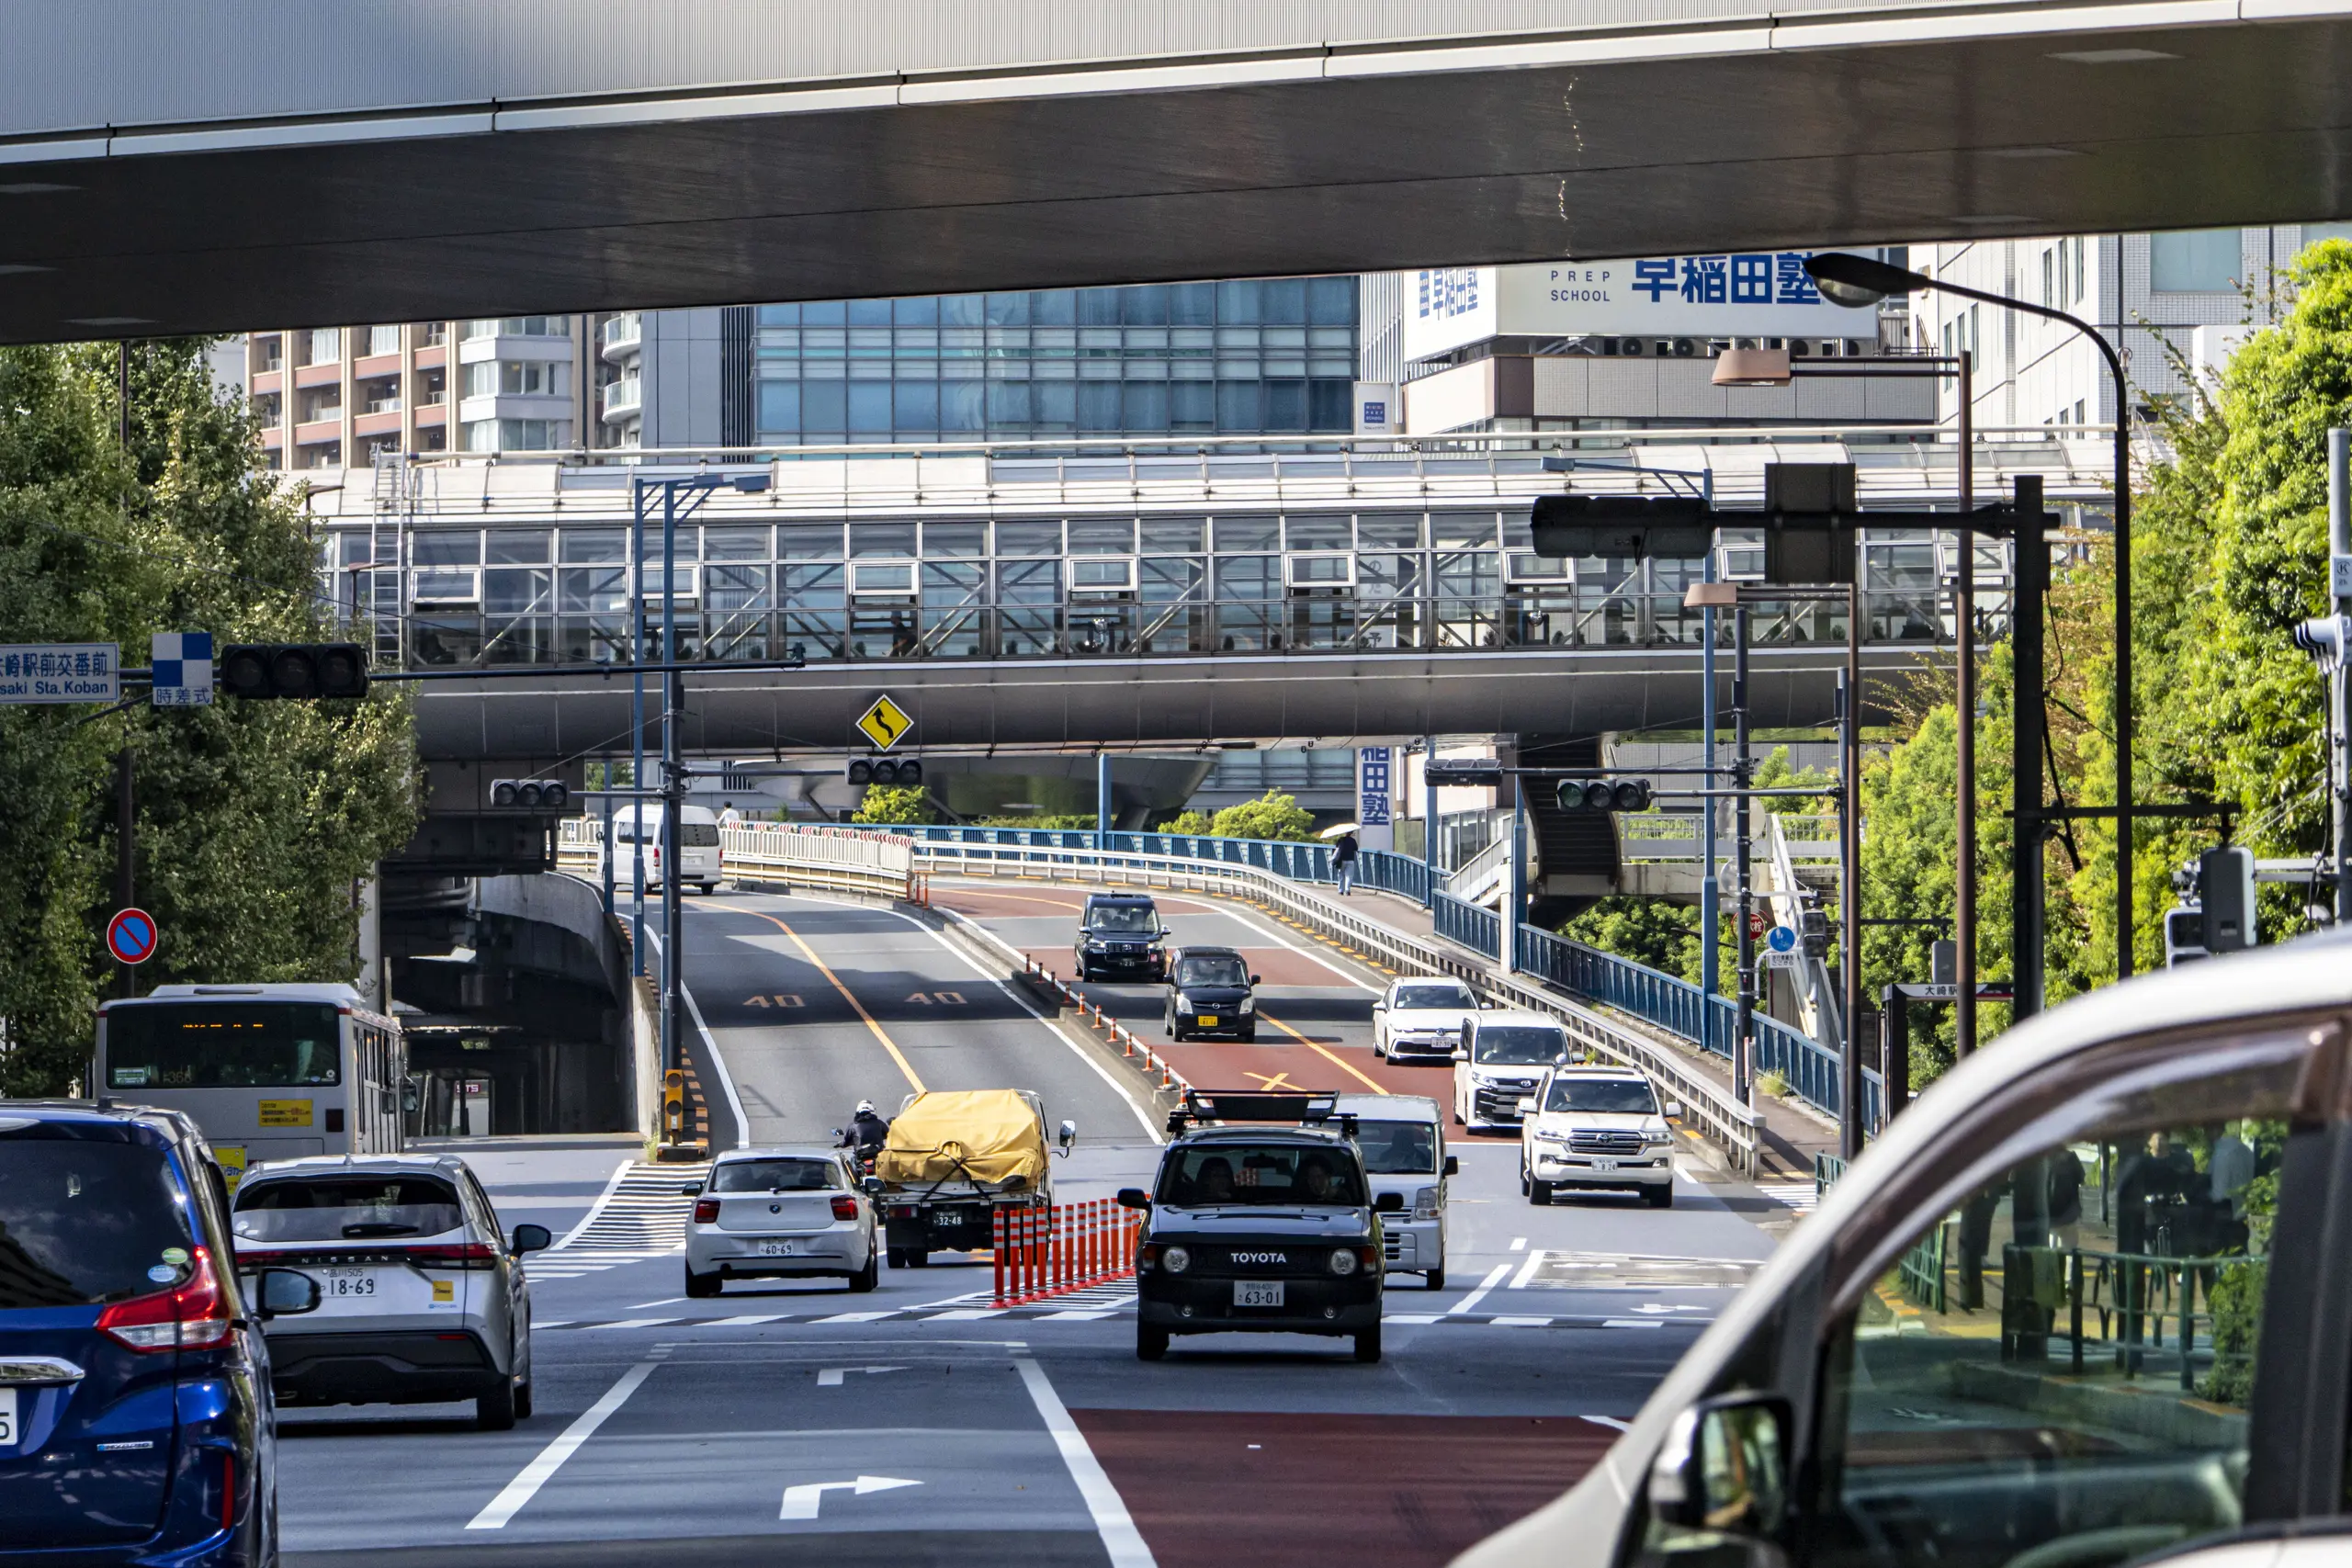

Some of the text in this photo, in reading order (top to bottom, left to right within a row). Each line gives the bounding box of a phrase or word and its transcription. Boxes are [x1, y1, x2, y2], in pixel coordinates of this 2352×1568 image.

[1551, 270, 1611, 282] PREP
[1632, 252, 1821, 304] 早稲田塾
[1551, 290, 1611, 302] SCHOOL
[0, 651, 107, 677] 崎駅前交番前
[64, 681, 108, 694] Koban
[156, 688, 210, 704] 時差式
[742, 995, 807, 1008] 40
[904, 992, 968, 1005] 40
[939, 1216, 962, 1225] 32-48
[765, 1245, 792, 1255] 60-69
[301, 1256, 389, 1264] NISSAN
[1230, 1252, 1286, 1263] TOYOTA
[331, 1279, 374, 1294] 18-69
[1245, 1292, 1279, 1304] 63-01
